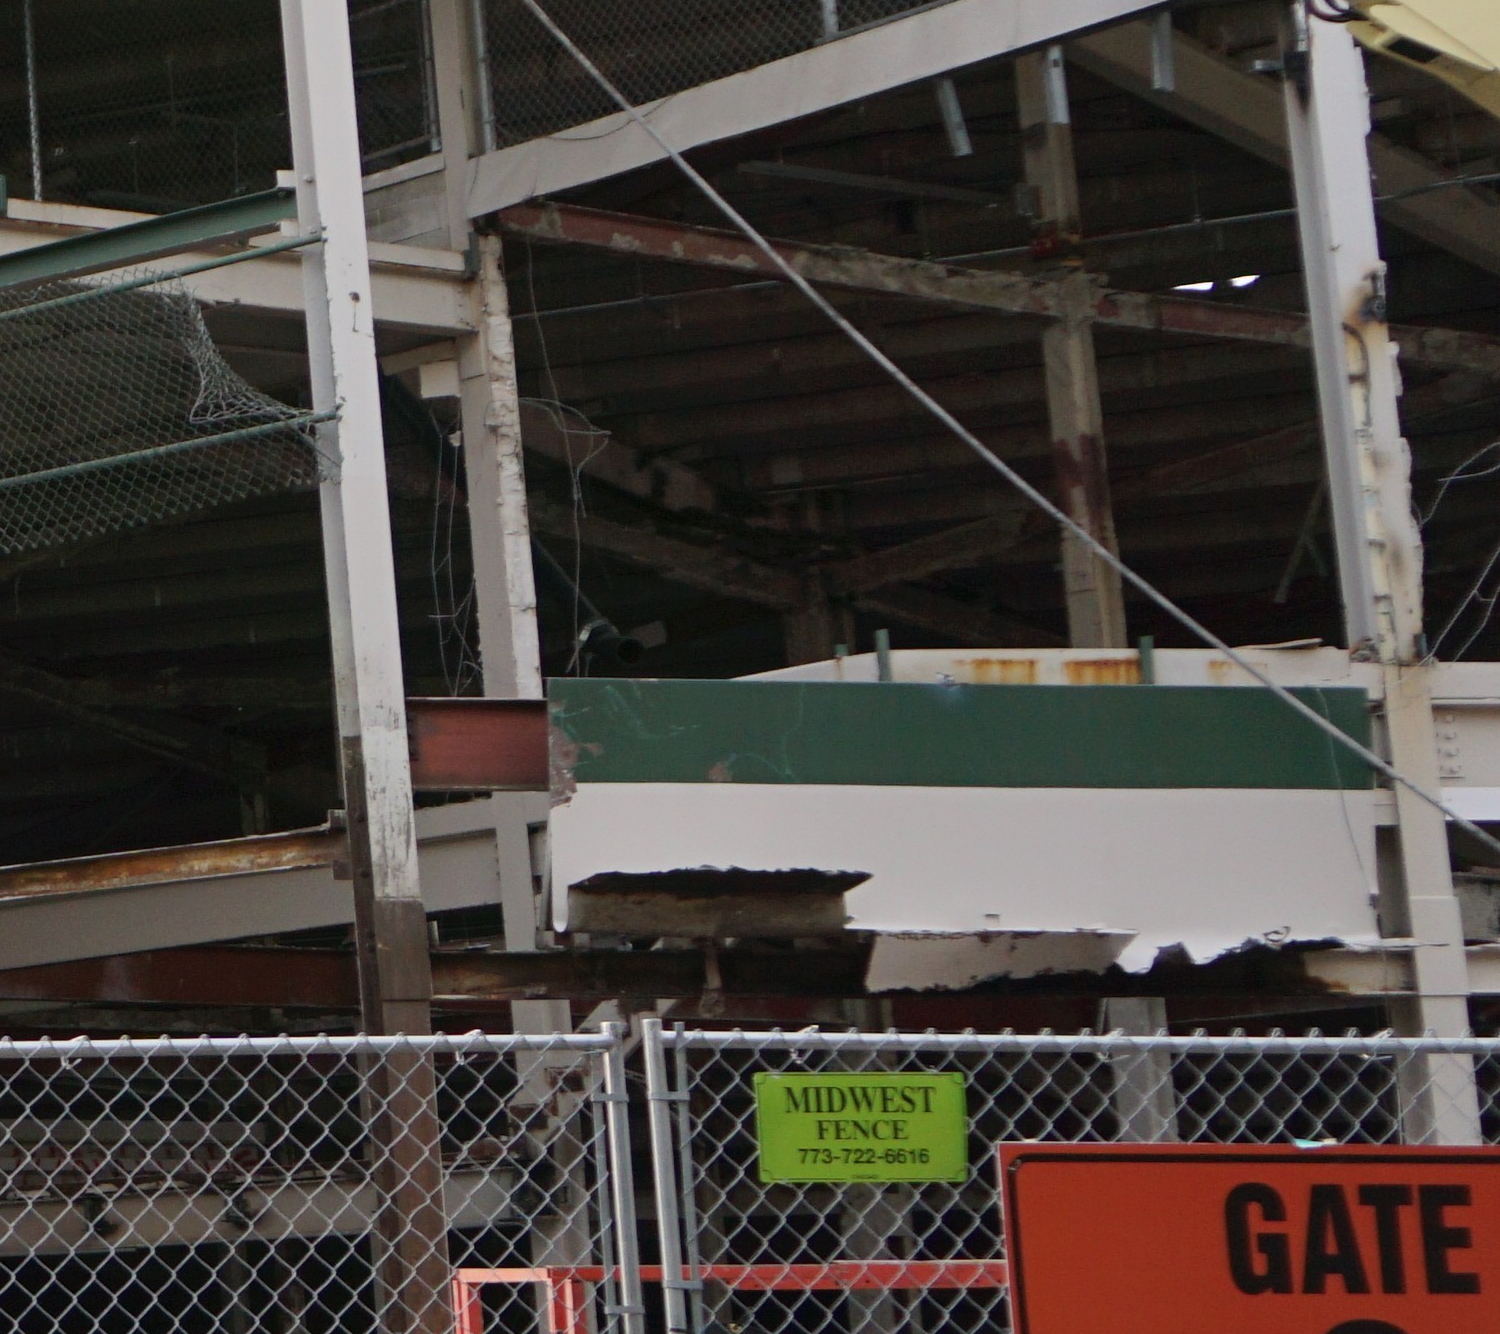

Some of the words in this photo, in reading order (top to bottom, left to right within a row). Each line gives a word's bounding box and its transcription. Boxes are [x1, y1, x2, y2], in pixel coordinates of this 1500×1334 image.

[784, 1086, 936, 1114] MIDWEST
[817, 1119, 909, 1140] FENCE
[798, 1148, 930, 1165] 773-722-6616
[1224, 1182, 1482, 1296] GATE
